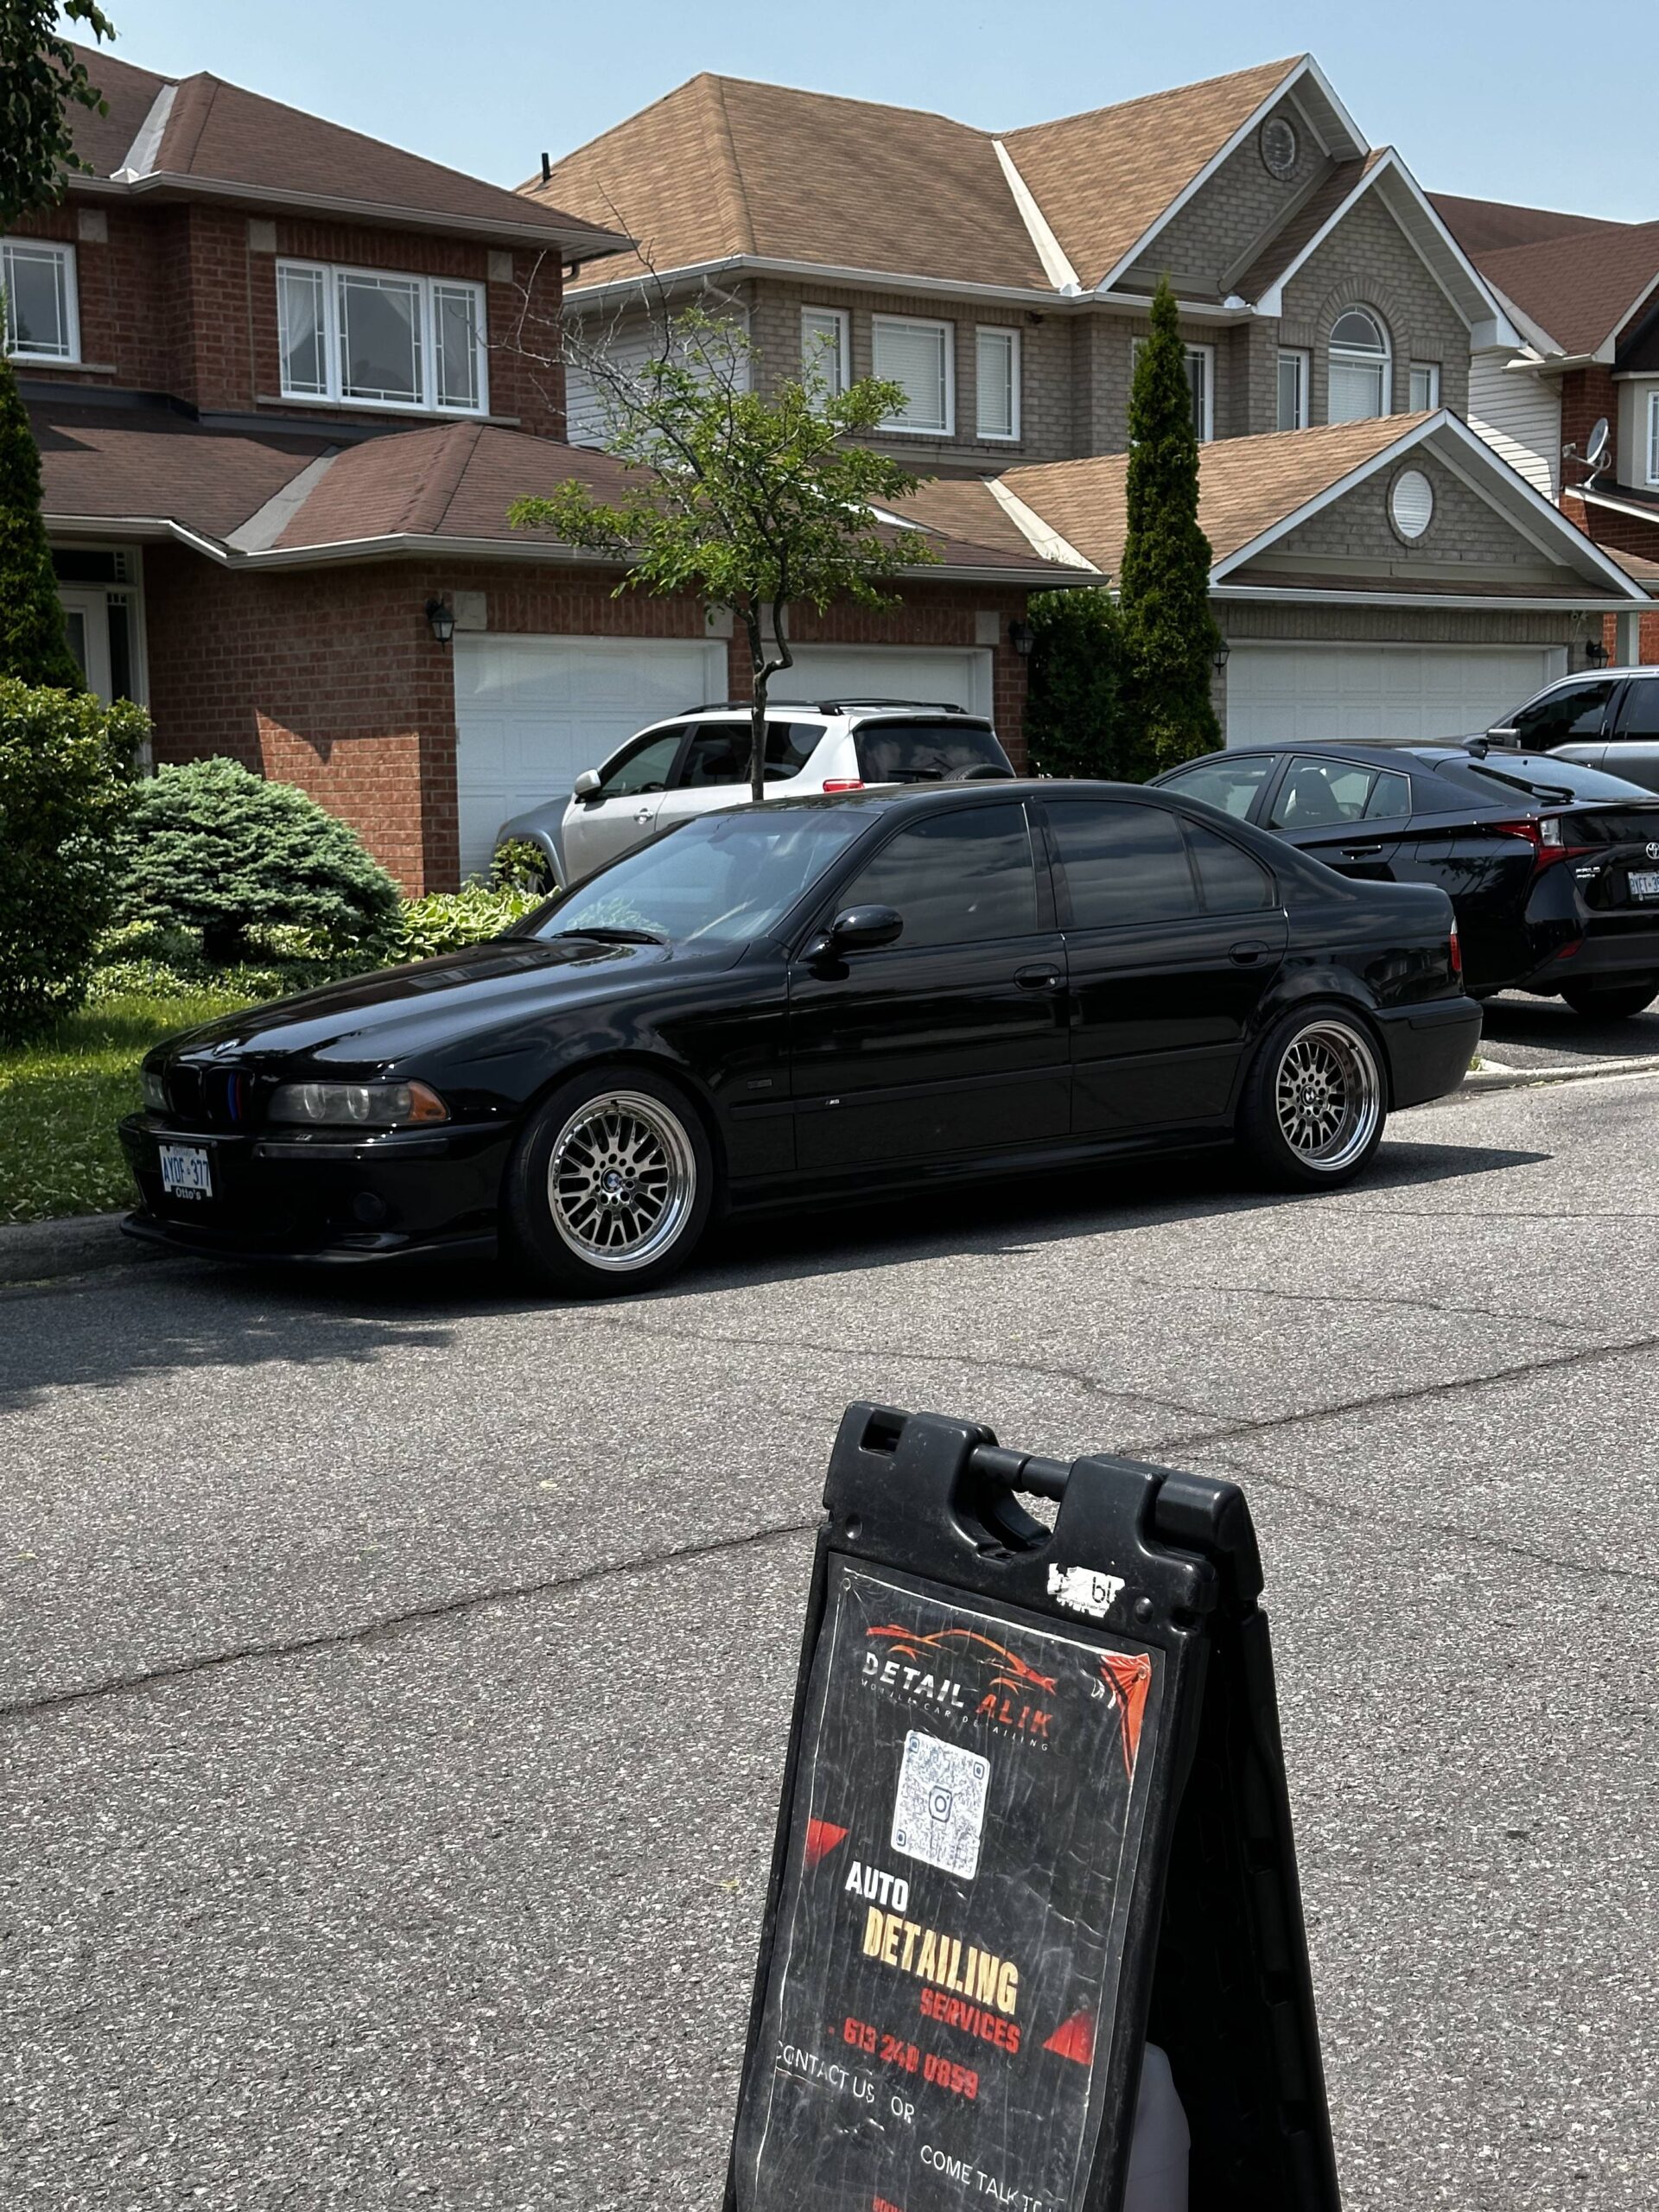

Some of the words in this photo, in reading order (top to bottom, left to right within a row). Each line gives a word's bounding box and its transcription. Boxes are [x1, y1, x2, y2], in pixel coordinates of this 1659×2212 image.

[862, 1651, 964, 1708] DETAIL
[976, 1694, 1053, 1738] ALIK
[924, 1703, 951, 1718] CAR
[845, 1860, 909, 1912] AUTO
[863, 1905, 1019, 2015] DETAILING
[919, 1987, 1021, 2054] SERVICES
[843, 2017, 877, 2054] 613
[880, 2034, 920, 2073] 240
[924, 2054, 979, 2100] 0859
[853, 2075, 874, 2103] US
[891, 2095, 915, 2124] OR
[920, 2145, 974, 2184] COME
[976, 2171, 1019, 2204] TALK
